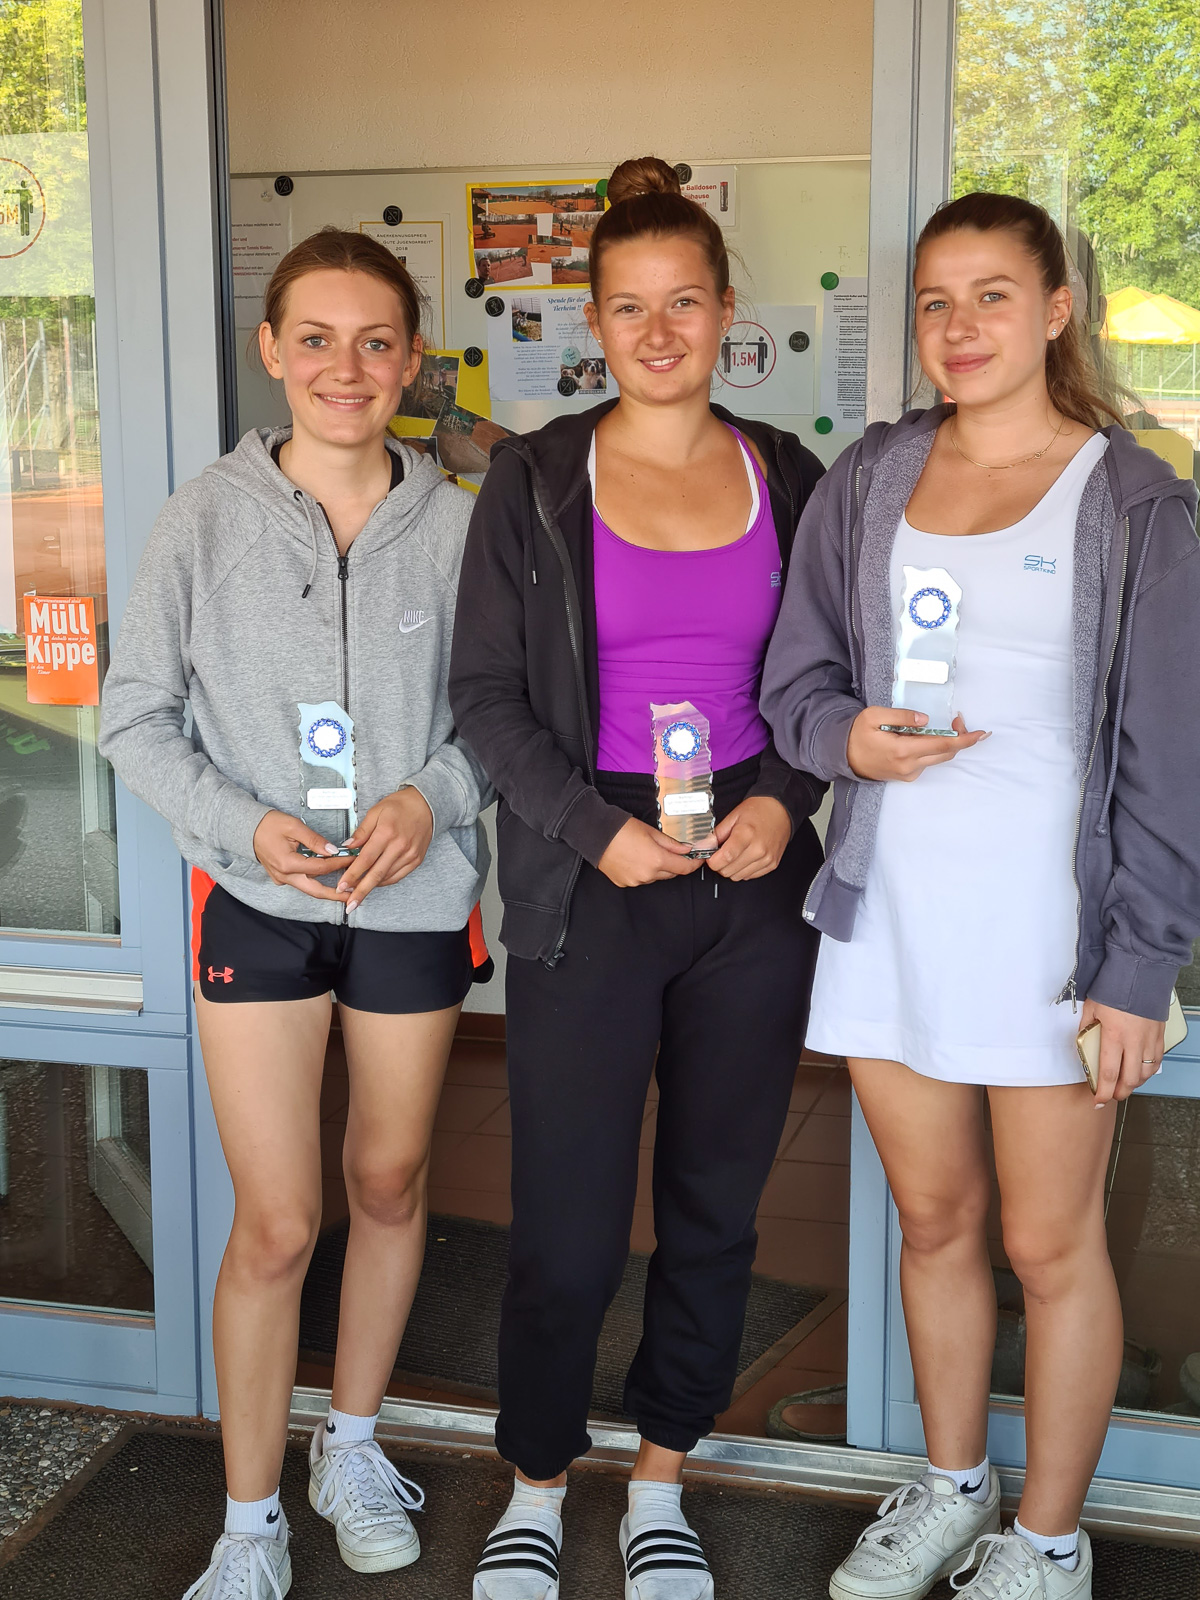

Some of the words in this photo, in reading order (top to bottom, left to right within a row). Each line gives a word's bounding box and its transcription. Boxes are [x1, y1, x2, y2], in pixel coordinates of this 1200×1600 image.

[0, 203, 18, 225] 5M
[567, 296, 576, 304] für
[731, 351, 757, 367] 1,5M
[30, 602, 90, 635] Müll
[27, 635, 96, 671] Kippe
